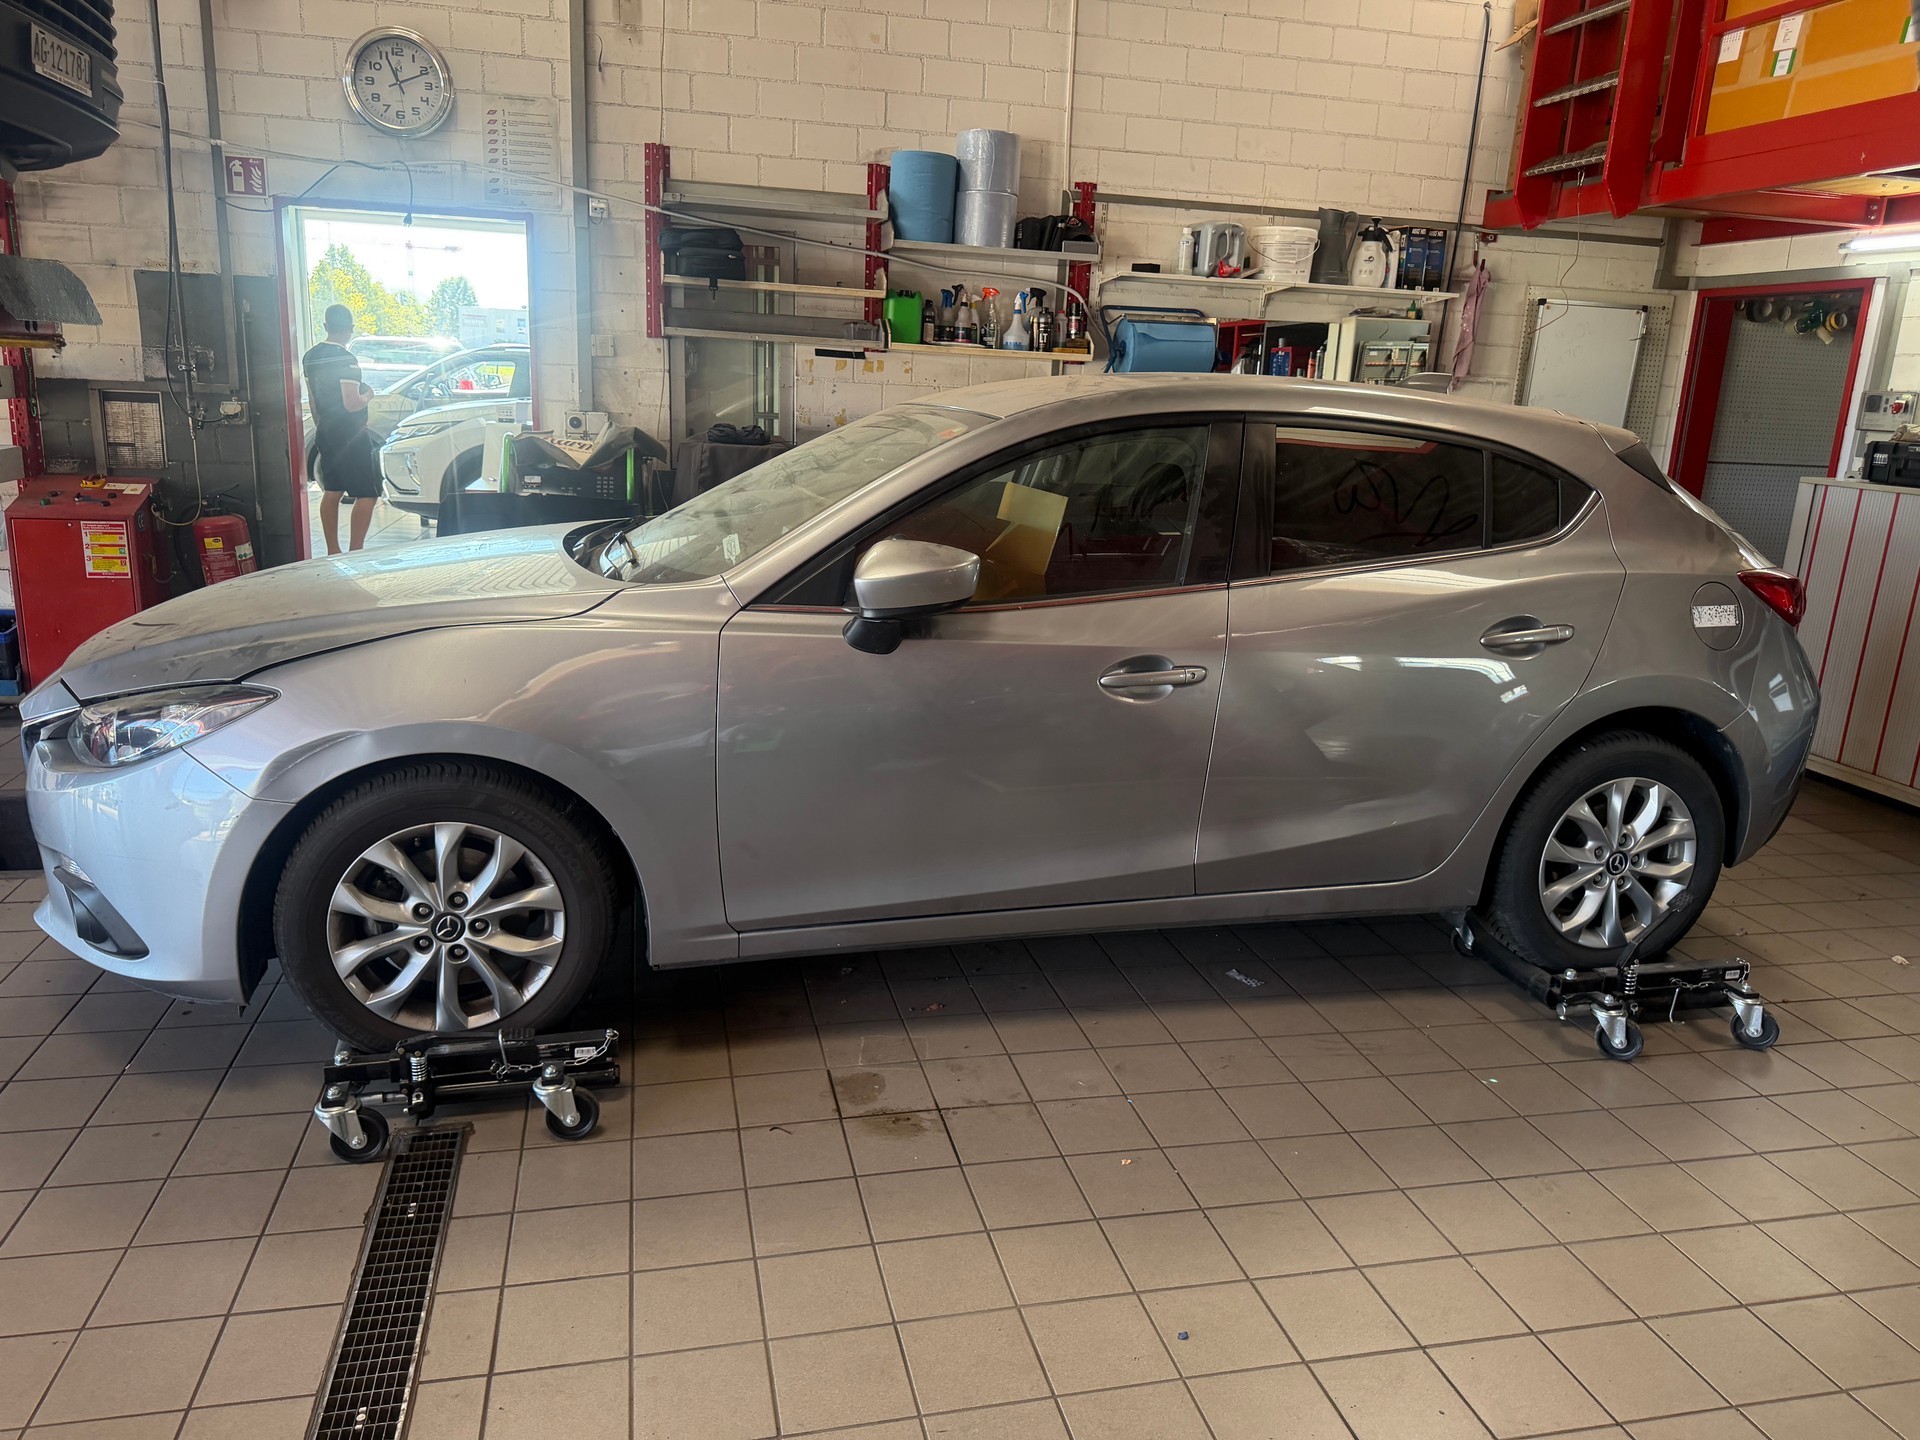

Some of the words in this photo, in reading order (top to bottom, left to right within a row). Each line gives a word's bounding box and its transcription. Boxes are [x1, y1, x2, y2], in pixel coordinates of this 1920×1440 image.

[391, 47, 404, 57] 12
[411, 54, 415, 63] 1
[369, 61, 382, 71] 10
[419, 66, 429, 76] 2
[364, 76, 375, 86] 9
[424, 82, 433, 91] 3
[371, 93, 381, 102] 8
[420, 97, 429, 106] 4
[382, 104, 391, 113] 7
[412, 107, 420, 116] 5
[502, 109, 506, 117] 1
[396, 110, 405, 119] 6
[502, 119, 507, 127] 2
[502, 129, 507, 137] 3
